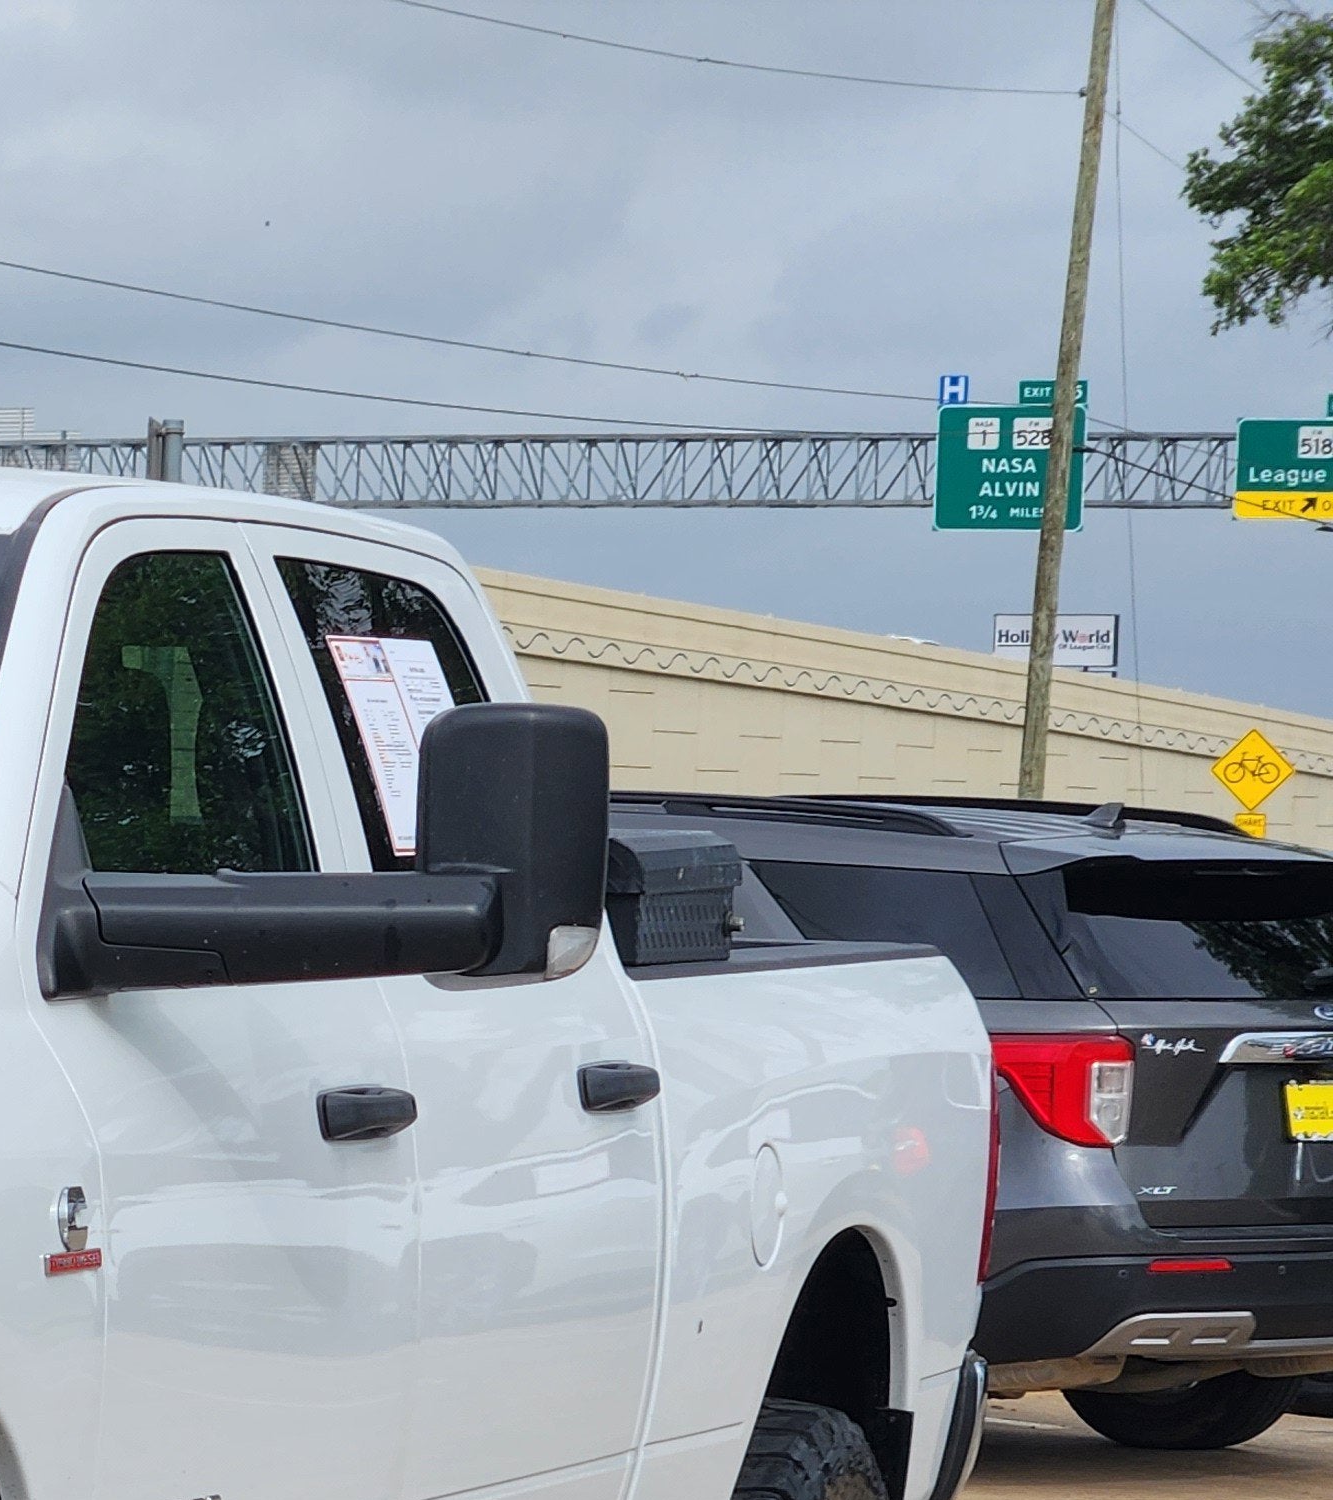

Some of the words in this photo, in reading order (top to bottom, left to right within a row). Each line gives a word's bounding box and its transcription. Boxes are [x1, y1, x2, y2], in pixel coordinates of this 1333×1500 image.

[942, 377, 967, 404] H
[1023, 387, 1052, 398] EXIT
[1016, 429, 1053, 446] 528
[1300, 438, 1333, 455] 518
[981, 457, 1037, 474] NASA
[1248, 466, 1327, 488] League
[978, 481, 1040, 497] ALVIN
[1262, 500, 1296, 512] EXIT
[1136, 1186, 1177, 1196] XLT
